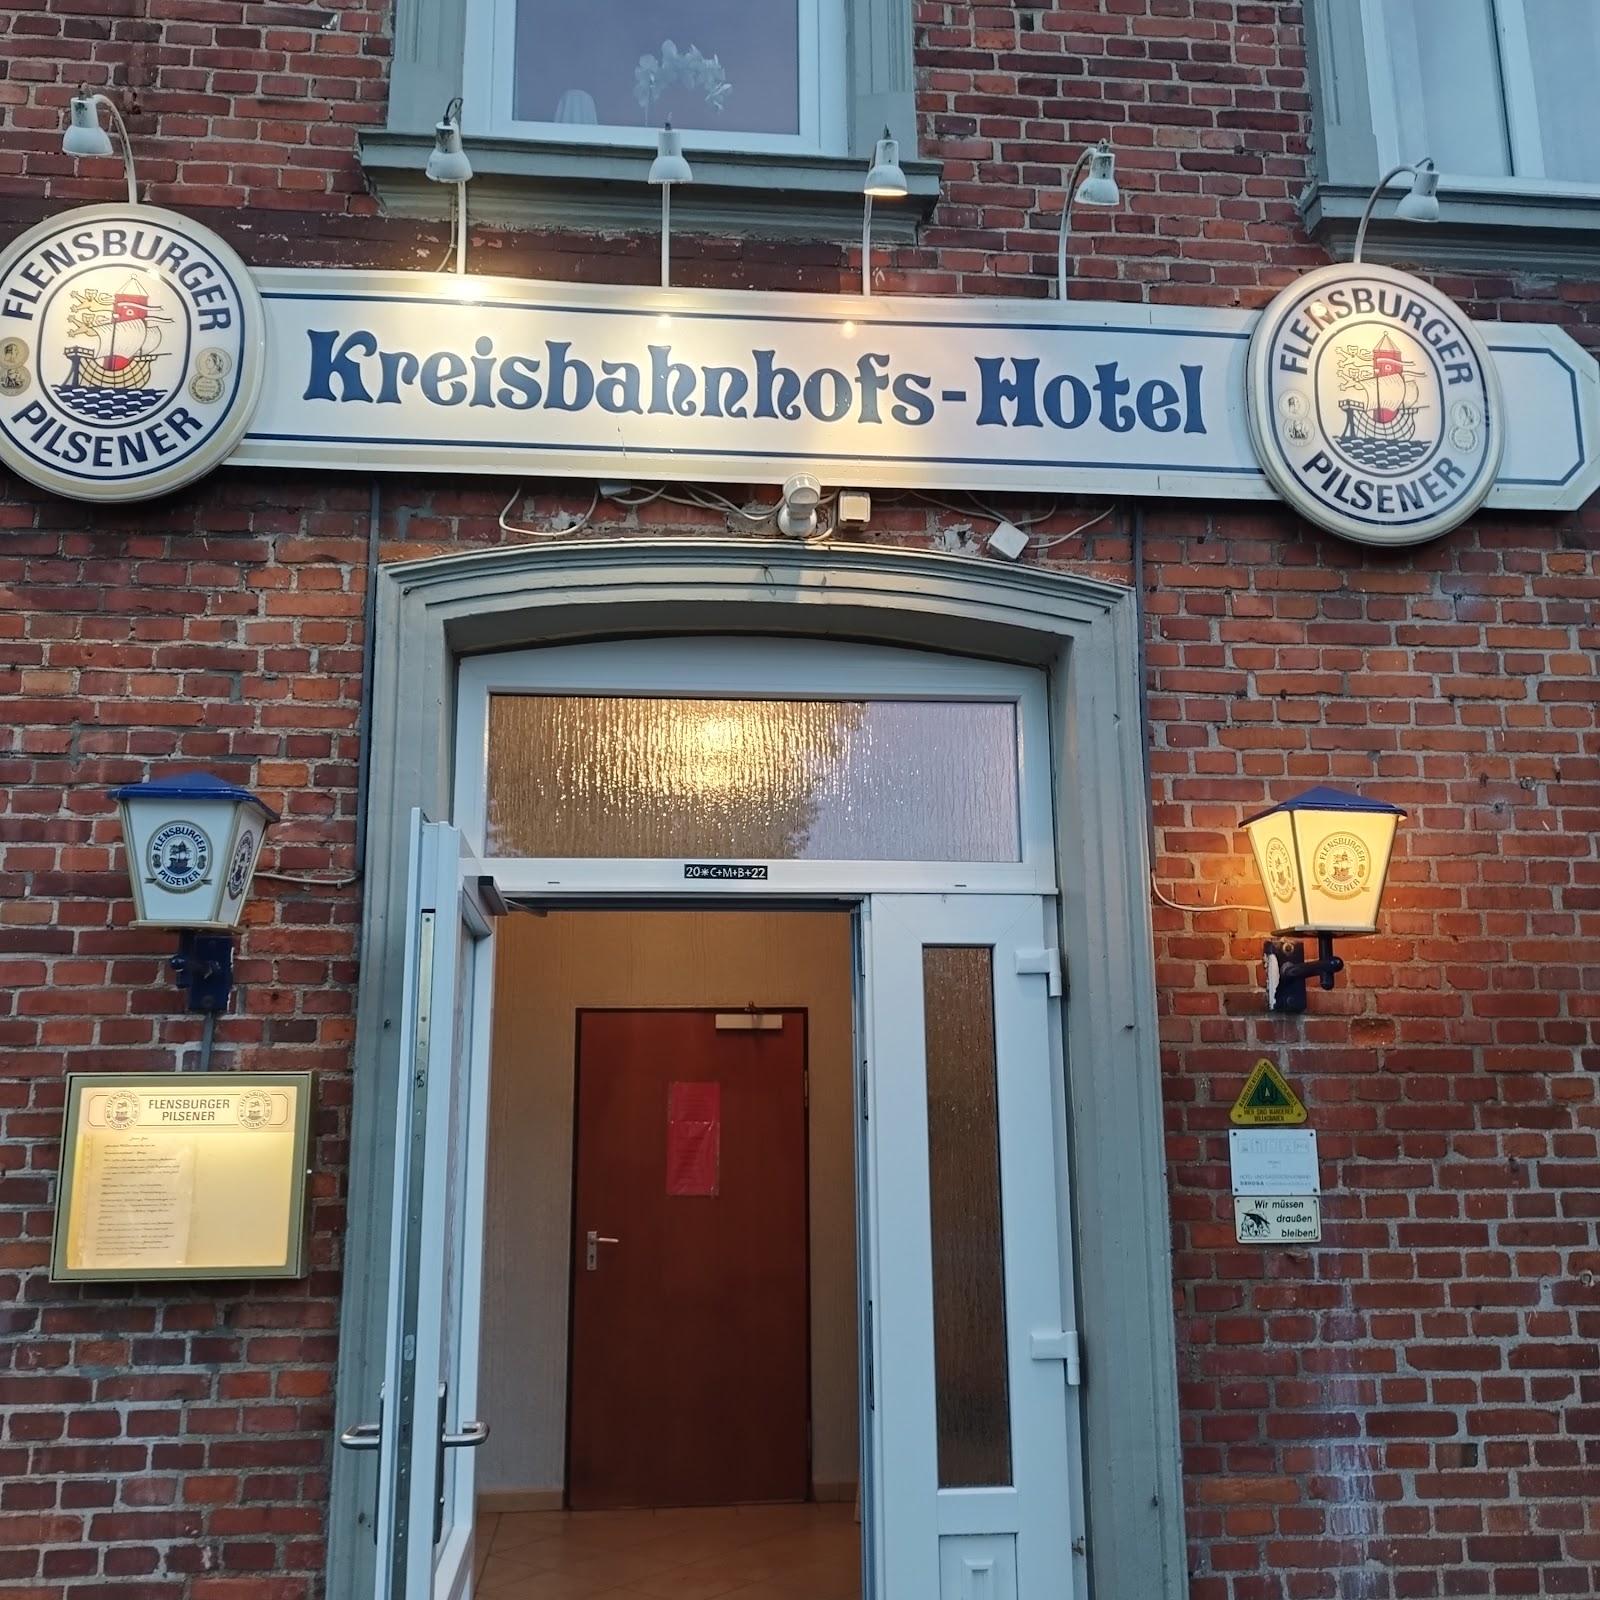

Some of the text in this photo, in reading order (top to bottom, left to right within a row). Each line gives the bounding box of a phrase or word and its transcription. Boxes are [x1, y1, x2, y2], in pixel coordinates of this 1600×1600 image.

[2, 229, 231, 331] FLENSBURGER
[1280, 288, 1474, 385] FLENSBURGER
[302, 328, 1208, 434] Kreisbahnhofs-Hotel
[11, 400, 203, 467] PILSENER
[1302, 450, 1466, 514] PILSENER
[153, 826, 207, 853] FLENSBURGER
[1319, 838, 1366, 862] FLENSBURGER
[158, 870, 201, 886] PILSENER
[1323, 877, 1361, 893] PILSENER
[148, 1099, 230, 1109] FLENSBURGER
[162, 1111, 215, 1121] PILSENER
[1254, 1200, 1304, 1209] Wir müssen
[1276, 1213, 1313, 1223] draußen
[1281, 1228, 1316, 1238] bleiben!
